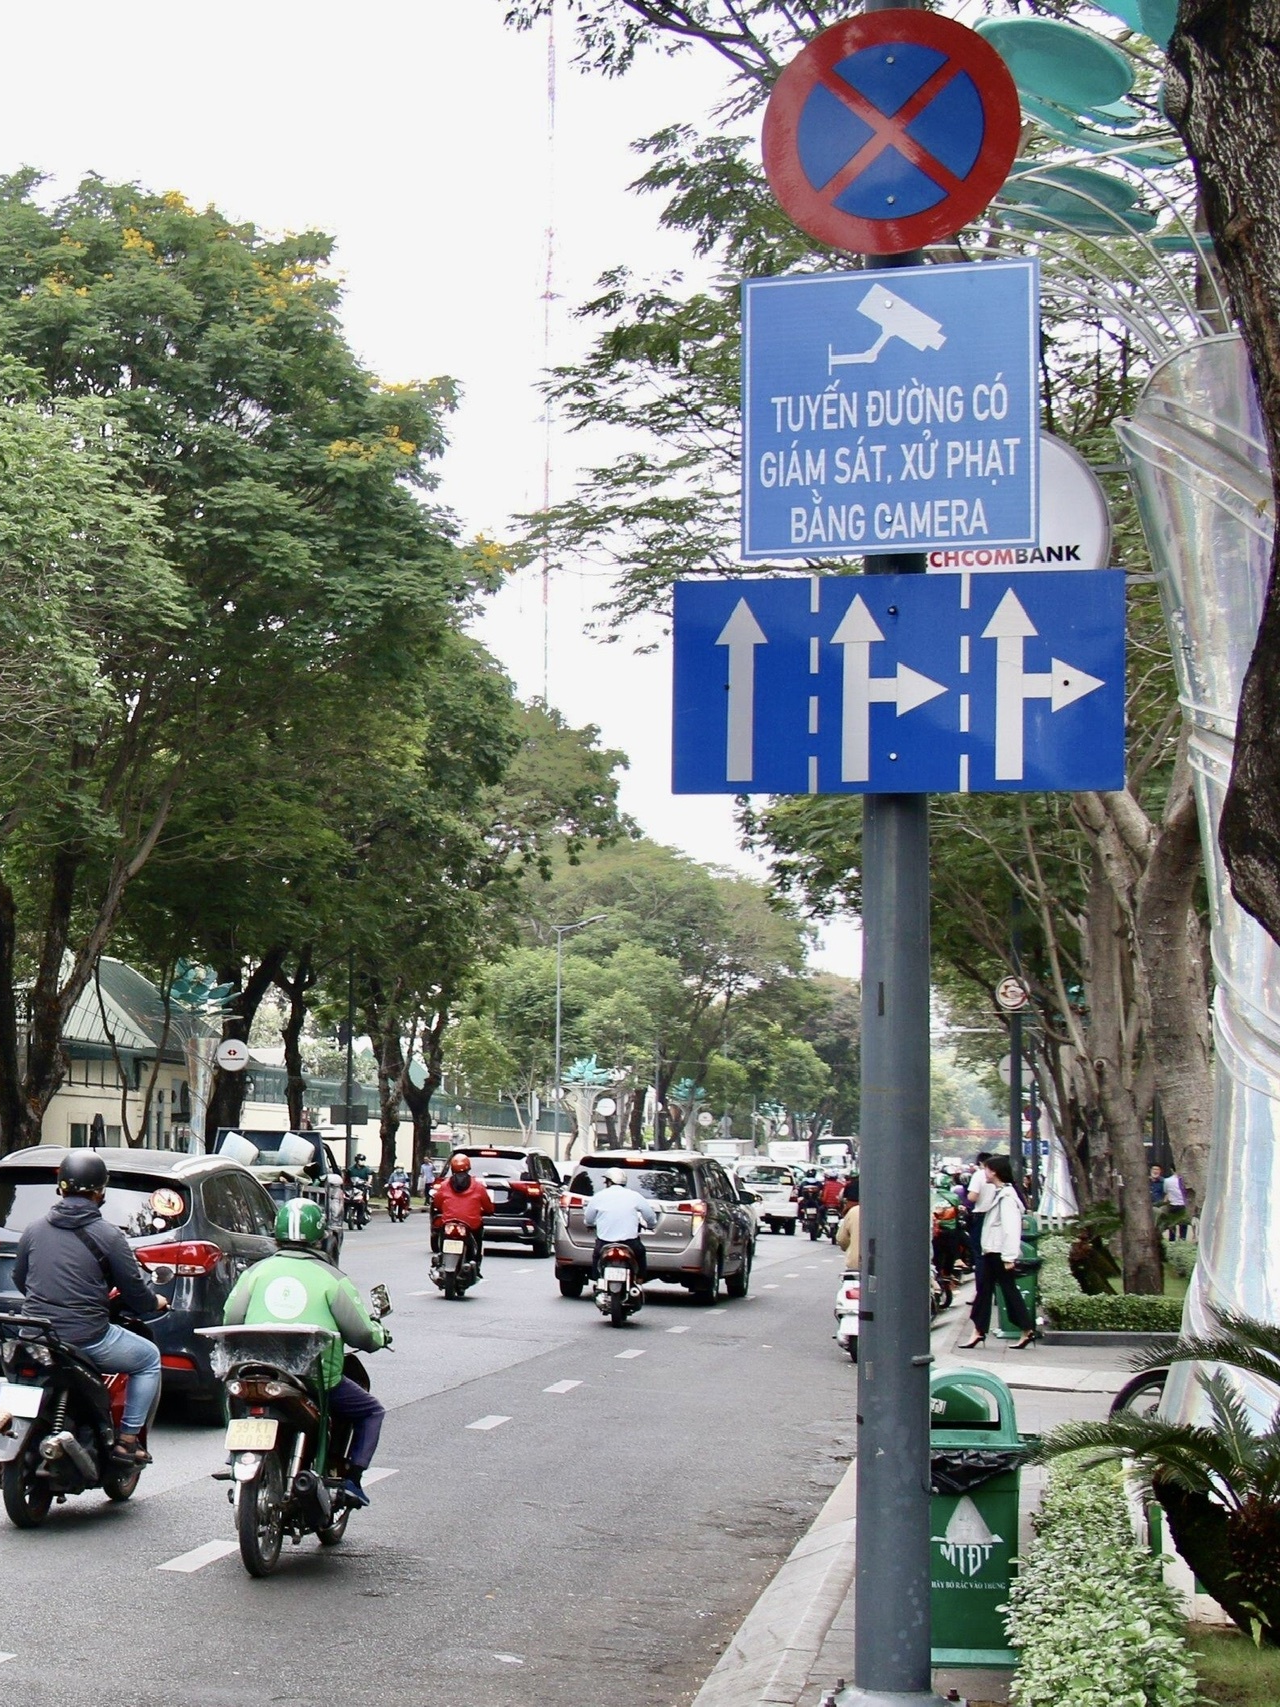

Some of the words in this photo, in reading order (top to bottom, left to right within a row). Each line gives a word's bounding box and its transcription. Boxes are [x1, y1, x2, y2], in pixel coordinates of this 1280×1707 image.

[771, 379, 857, 433] TUYẾN
[866, 377, 964, 427] ĐƯỜNG
[973, 372, 1008, 422] CÓ
[760, 440, 826, 488] GIÁM
[834, 436, 893, 484] SÁT,
[900, 429, 939, 481] XỬ
[947, 438, 1021, 486] PHẠT
[791, 489, 866, 544] BẰNG
[874, 498, 988, 540] CAMERA
[925, 544, 1081, 568] CHCOMBANK
[939, 1544, 993, 1577] MTĐT
